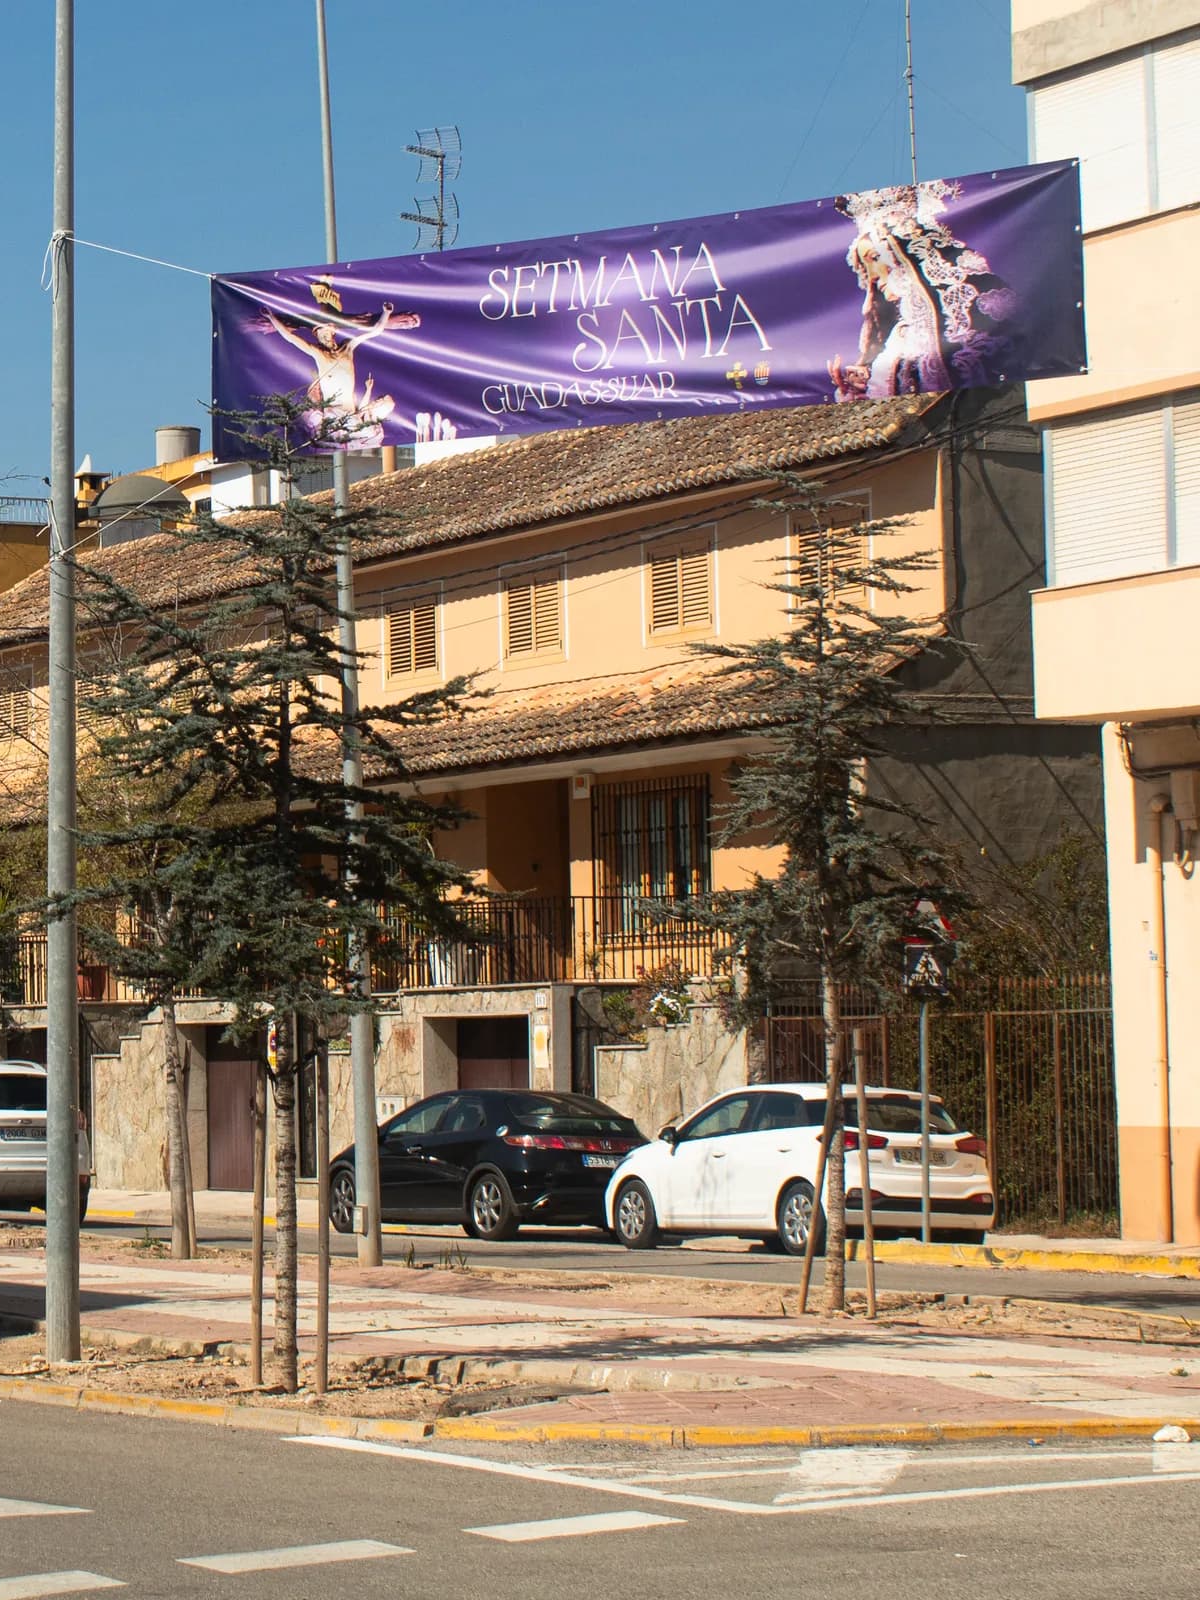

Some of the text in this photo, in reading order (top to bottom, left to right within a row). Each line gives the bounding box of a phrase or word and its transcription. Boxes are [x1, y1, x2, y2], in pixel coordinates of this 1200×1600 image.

[479, 242, 727, 320] SETMANA
[572, 293, 773, 373] SANTA
[481, 370, 679, 415] GUADASSUAR
